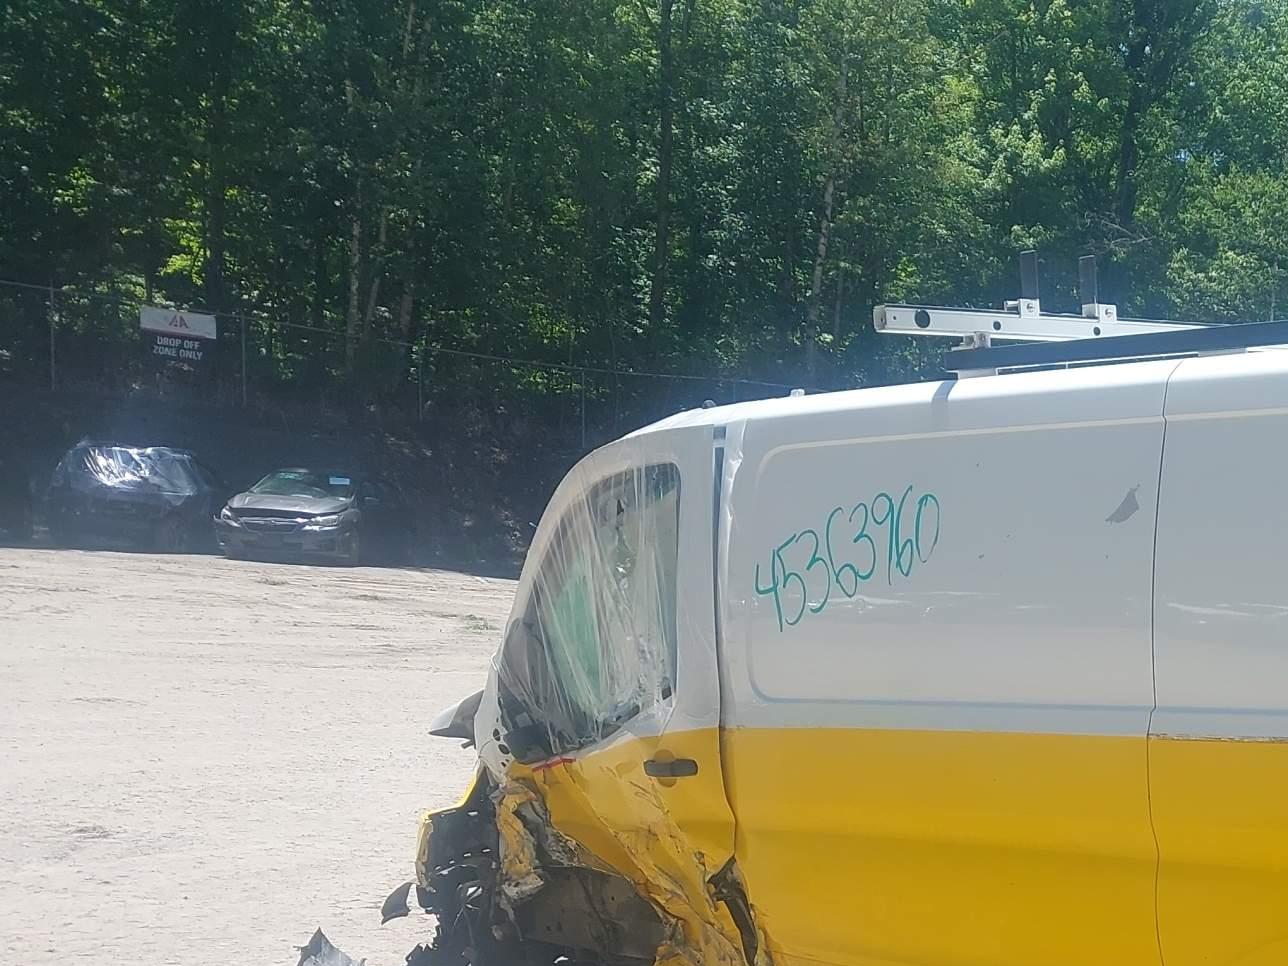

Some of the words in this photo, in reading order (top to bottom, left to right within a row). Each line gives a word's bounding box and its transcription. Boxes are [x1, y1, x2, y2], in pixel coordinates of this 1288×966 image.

[156, 335, 182, 348] DROP
[183, 340, 201, 350] OFF
[152, 344, 177, 357] ZONE
[179, 349, 203, 361] ONLY
[754, 485, 940, 633] 45363960
